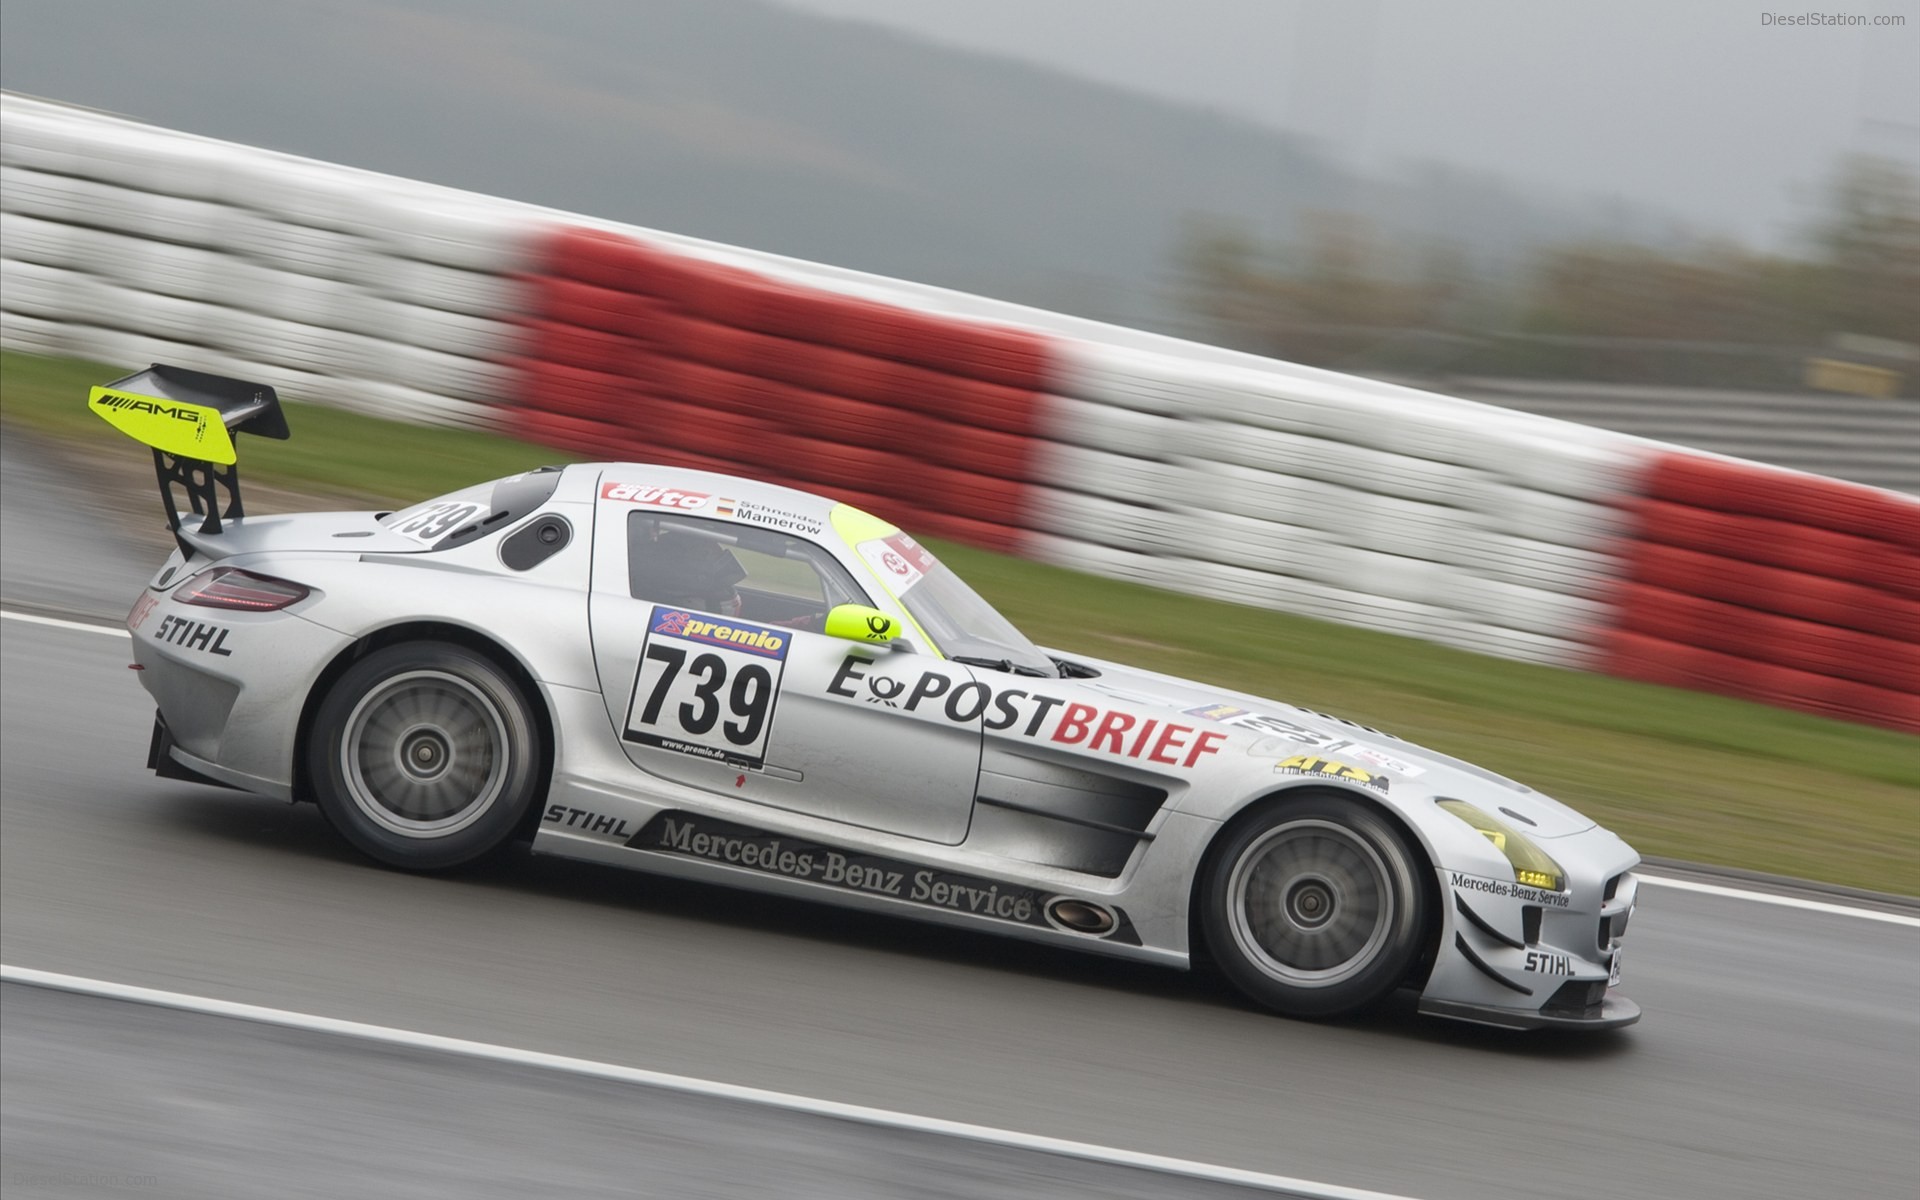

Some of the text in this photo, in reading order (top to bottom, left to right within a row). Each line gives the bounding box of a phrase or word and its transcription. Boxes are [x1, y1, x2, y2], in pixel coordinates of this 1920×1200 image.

[129, 401, 200, 422] AMG
[607, 486, 709, 509] auto
[737, 508, 821, 535] Mamerow
[740, 501, 822, 526] Schneider
[154, 614, 232, 657] STIHL
[681, 618, 783, 651] premio
[640, 643, 772, 746] 739
[661, 739, 725, 760] www.premio.de
[543, 804, 631, 838] STIHL
[659, 816, 1033, 921] Mercedes-Benz Service
[1451, 873, 1570, 907] Mercedes-Benz Service
[1524, 952, 1576, 976] STIHL
